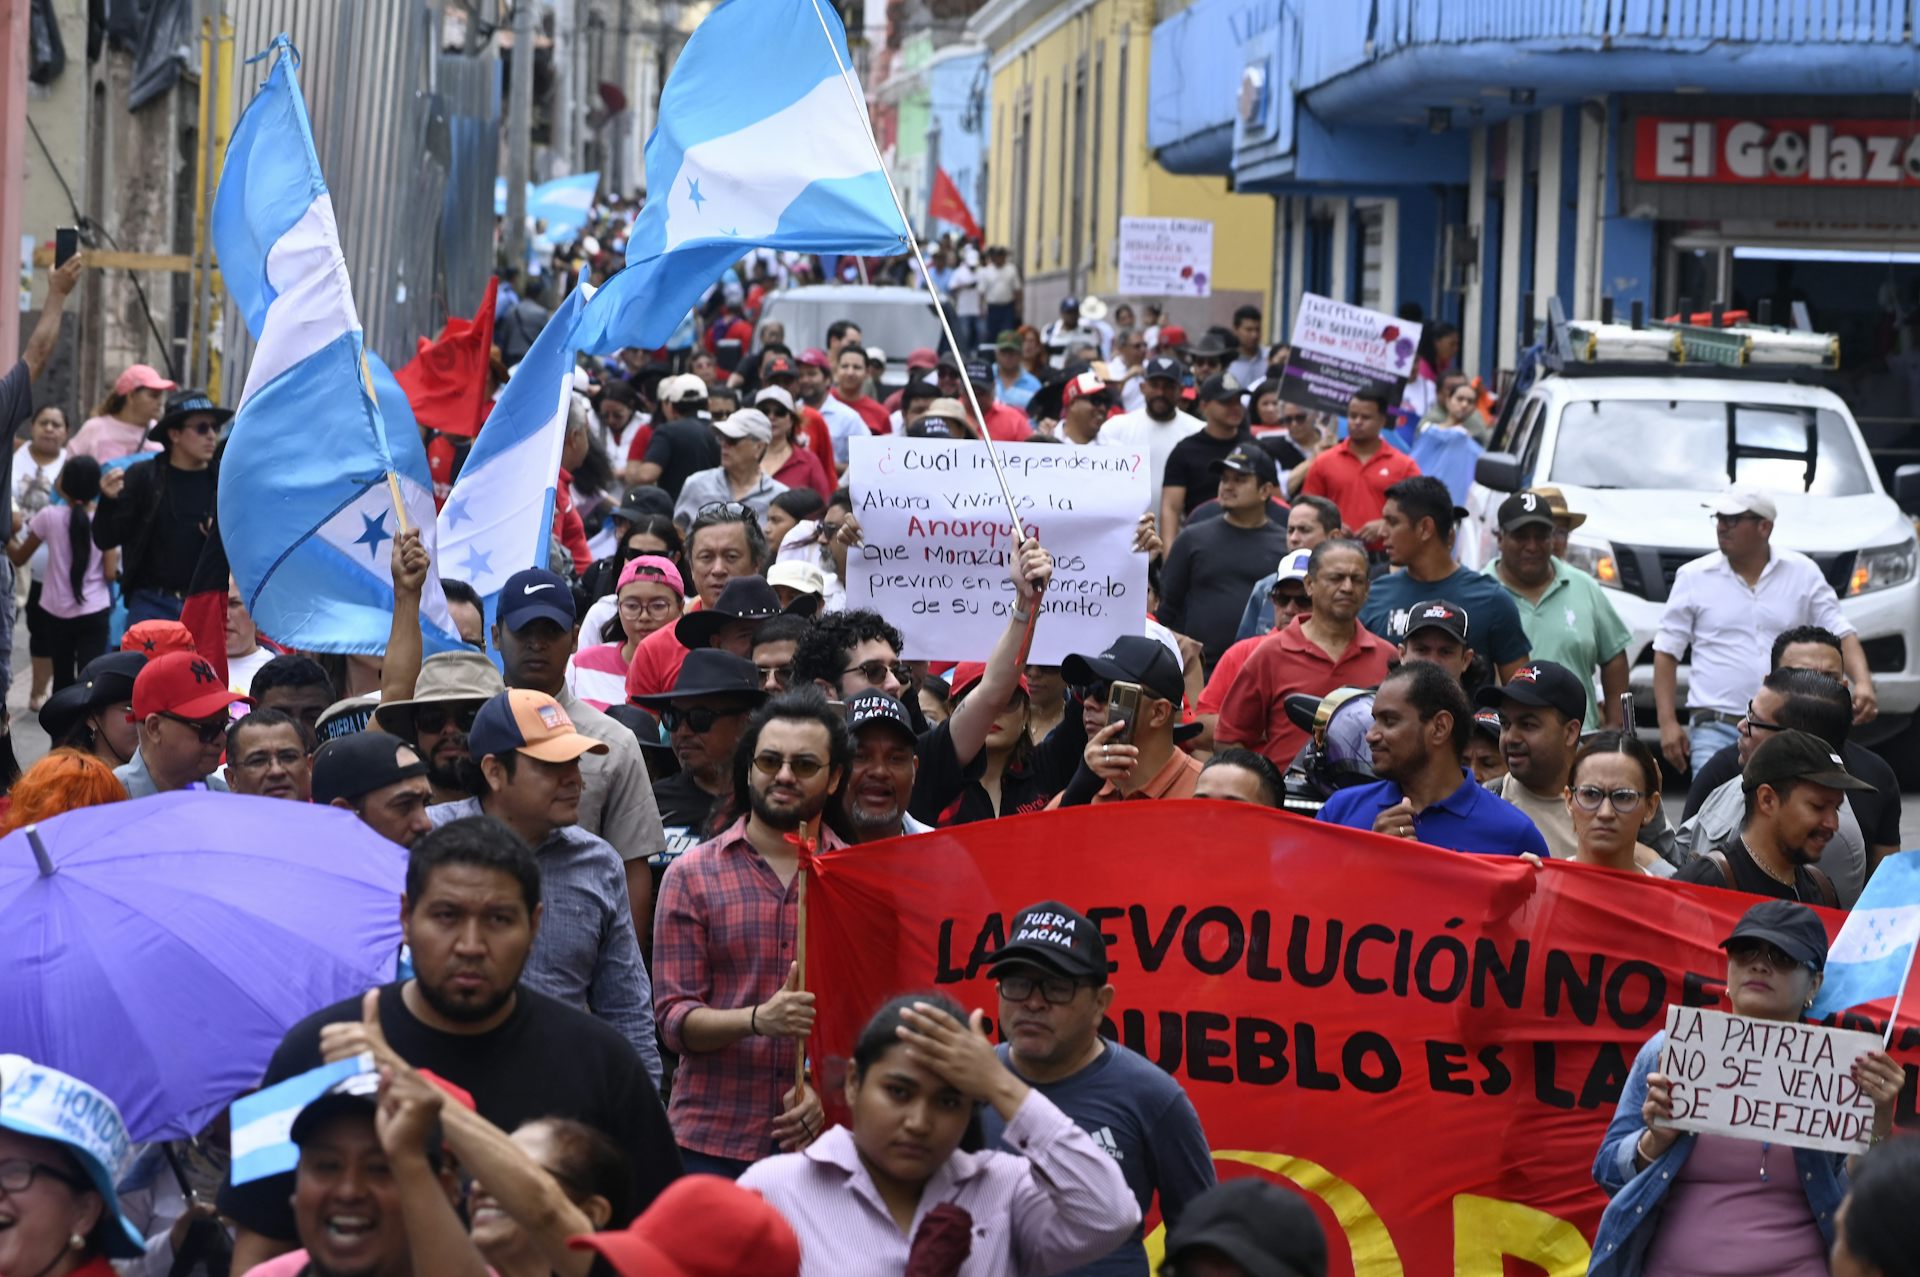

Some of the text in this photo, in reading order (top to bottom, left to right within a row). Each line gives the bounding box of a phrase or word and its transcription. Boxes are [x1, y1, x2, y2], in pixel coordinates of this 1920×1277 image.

[1656, 122, 1714, 177] El
[862, 490, 930, 511] Ahora
[1049, 493, 1073, 511] la
[869, 573, 953, 597] previno
[962, 577, 990, 590] en
[1048, 575, 1126, 597] omento
[912, 596, 1108, 617] de su asinato.
[854, 697, 898, 711] FUERA
[328, 715, 357, 740] FUERA
[1024, 912, 1076, 931] FUERA
[1017, 929, 1072, 948] RACHA
[935, 912, 1006, 984] LA
[1085, 904, 1530, 1009] EVOLUCIÓN
[1544, 949, 1667, 1029] NO
[1670, 1009, 1703, 1042] LA
[1721, 1018, 1834, 1068] PATRIA
[1425, 1040, 1511, 1096] ES
[1532, 1041, 1629, 1110] LA
[1666, 1045, 1706, 1081] NO
[1716, 1056, 1762, 1089] SE
[1778, 1065, 1873, 1109] VENDE
[1668, 1082, 1711, 1120] SE
[1730, 1094, 1874, 1144] DEFIENDE
